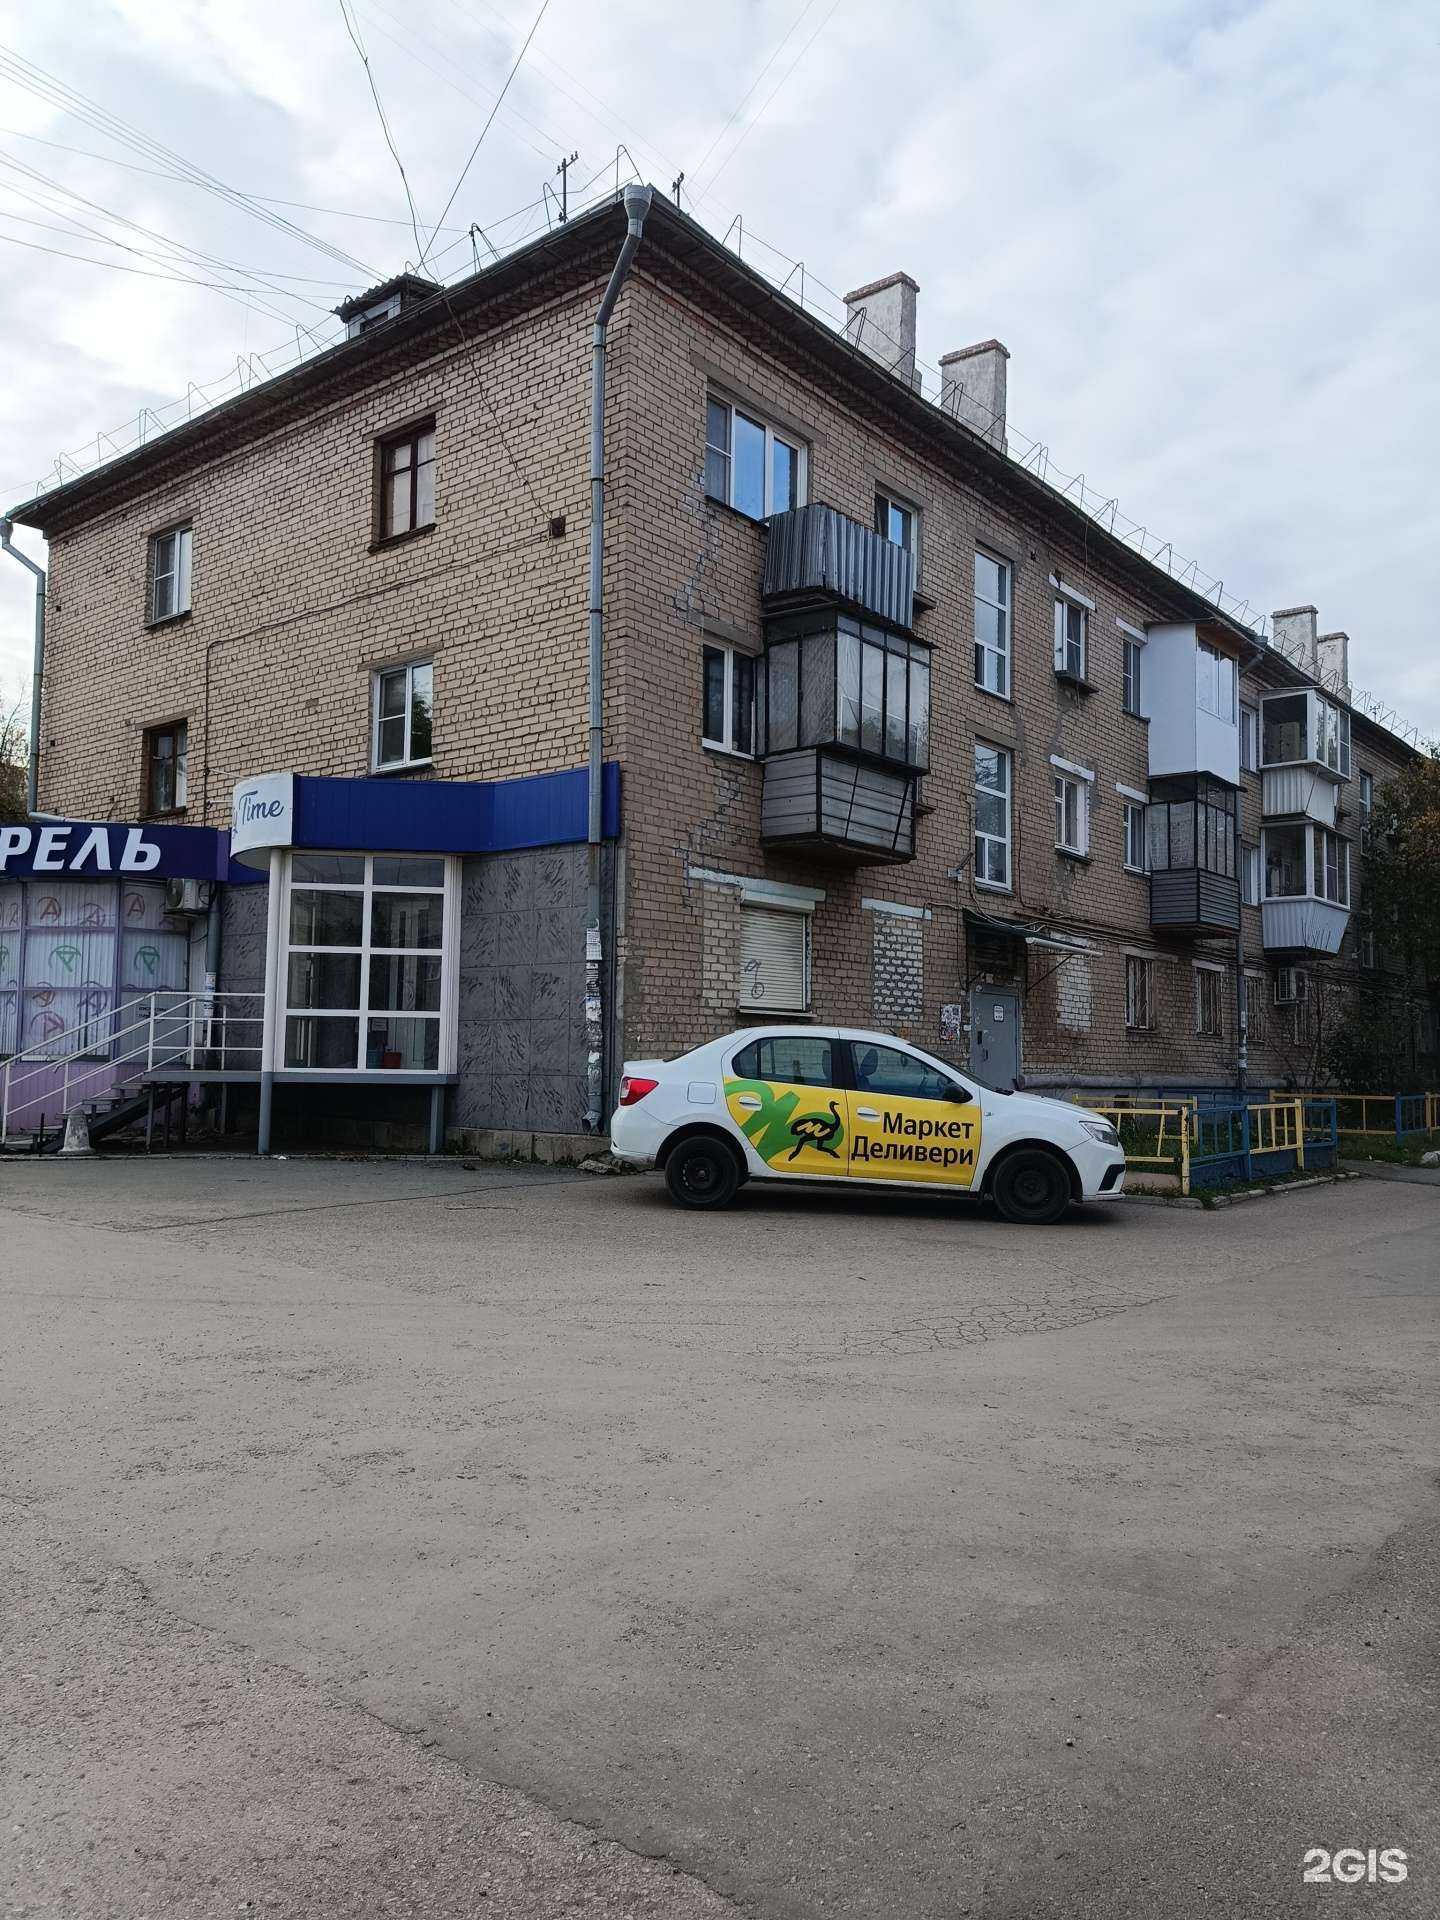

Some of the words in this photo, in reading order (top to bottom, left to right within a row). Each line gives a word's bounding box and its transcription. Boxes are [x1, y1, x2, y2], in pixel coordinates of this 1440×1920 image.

[238, 790, 284, 825] Time
[0, 826, 161, 871] РЕЛЬ
[882, 1111, 974, 1140] Маркет
[850, 1135, 974, 1168] Деливери
